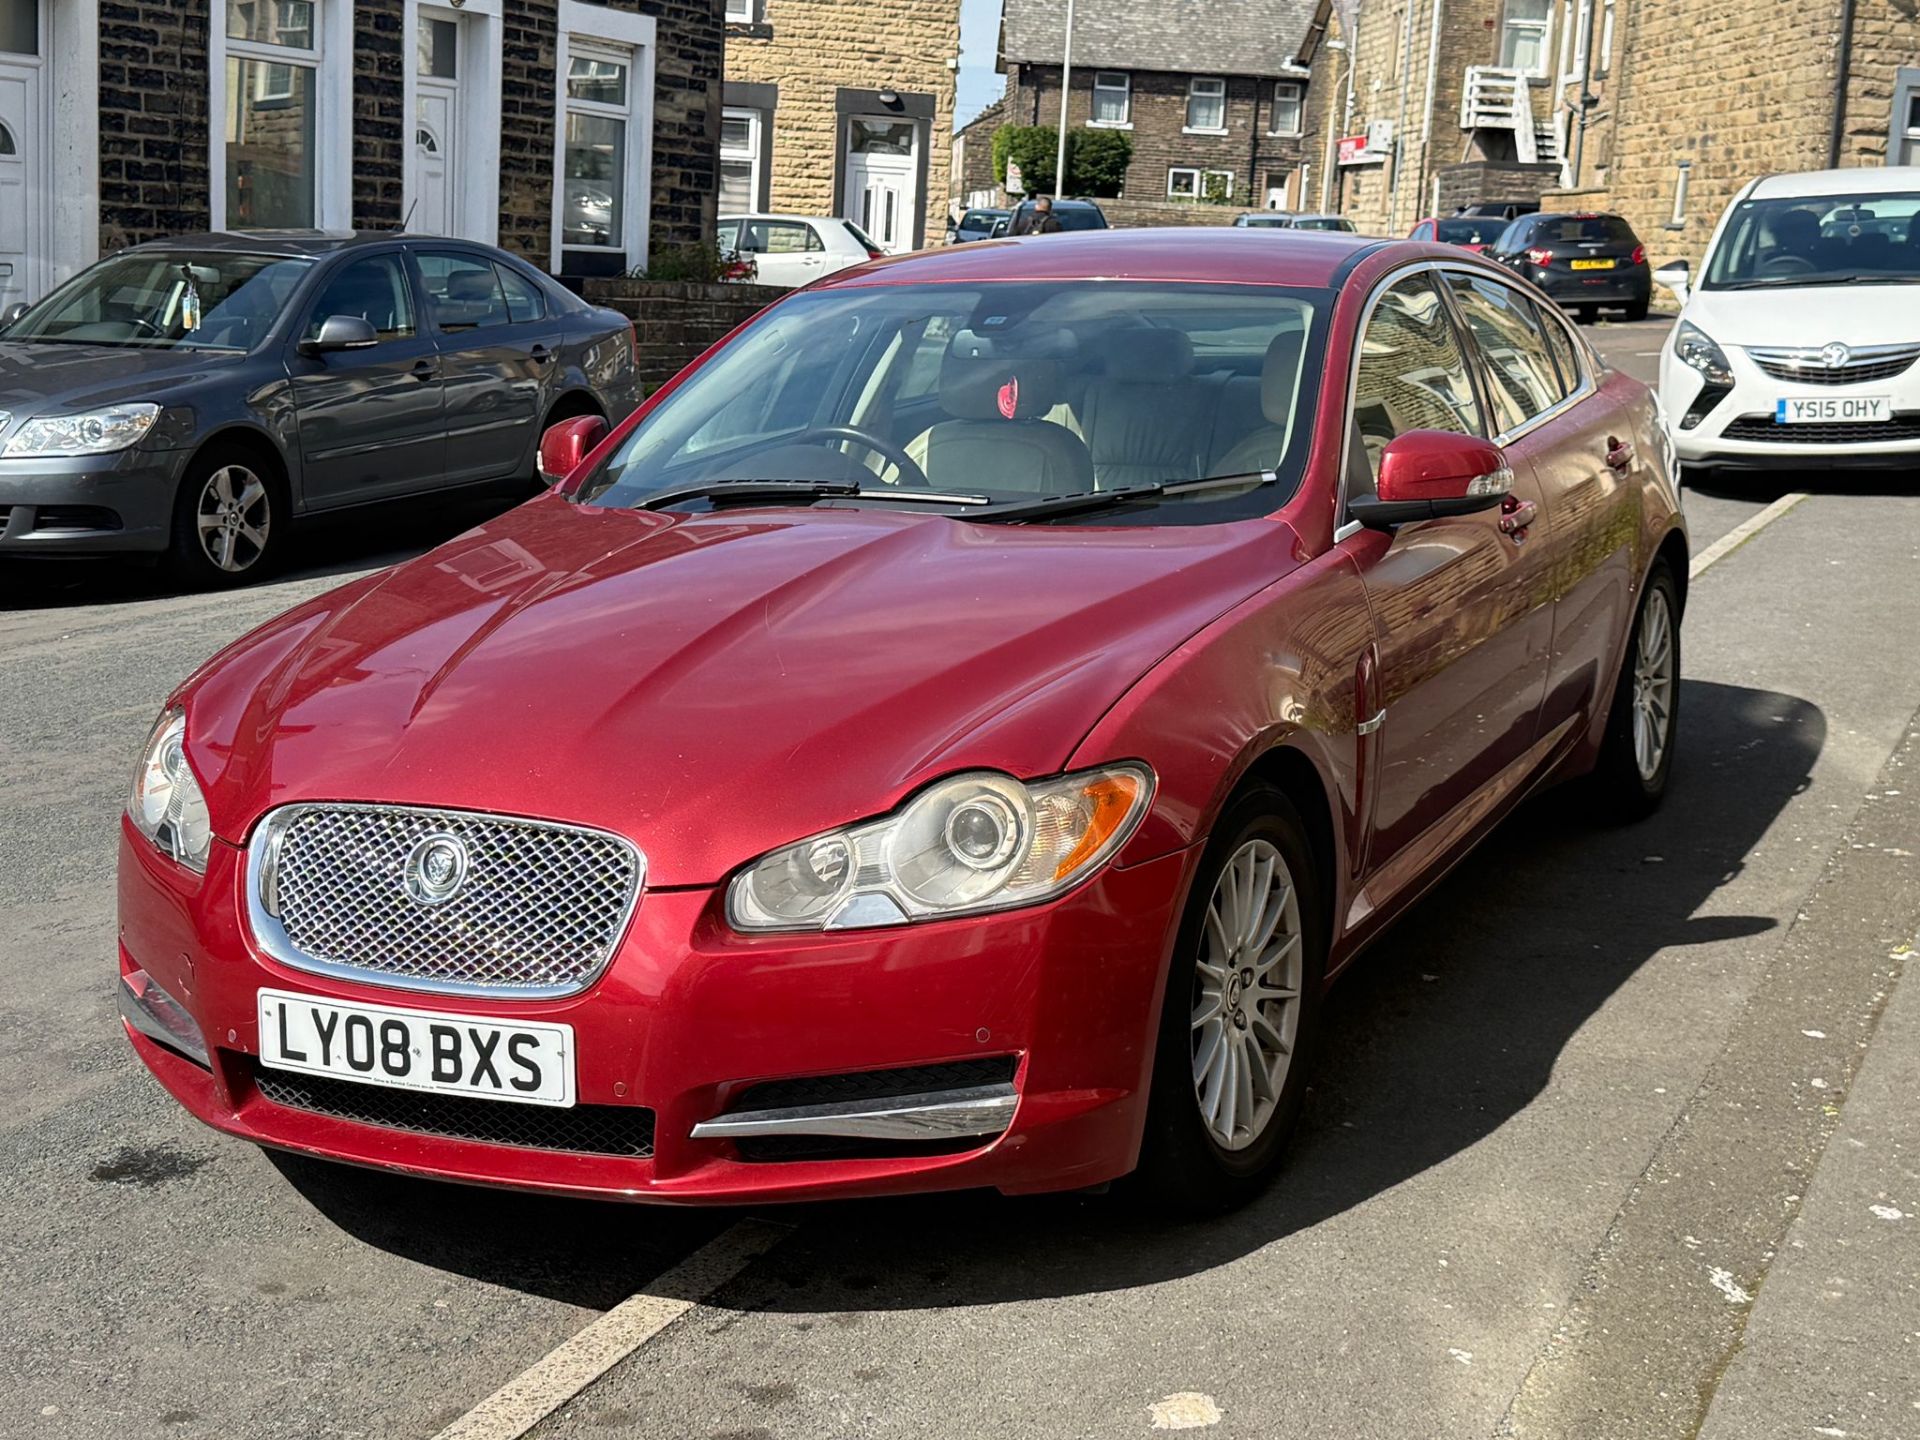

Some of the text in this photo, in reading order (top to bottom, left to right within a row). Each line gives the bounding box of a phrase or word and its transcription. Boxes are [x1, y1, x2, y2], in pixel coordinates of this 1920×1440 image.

[1793, 400, 1881, 418] YS15 OHY
[278, 1002, 543, 1093] LY08 BXS
